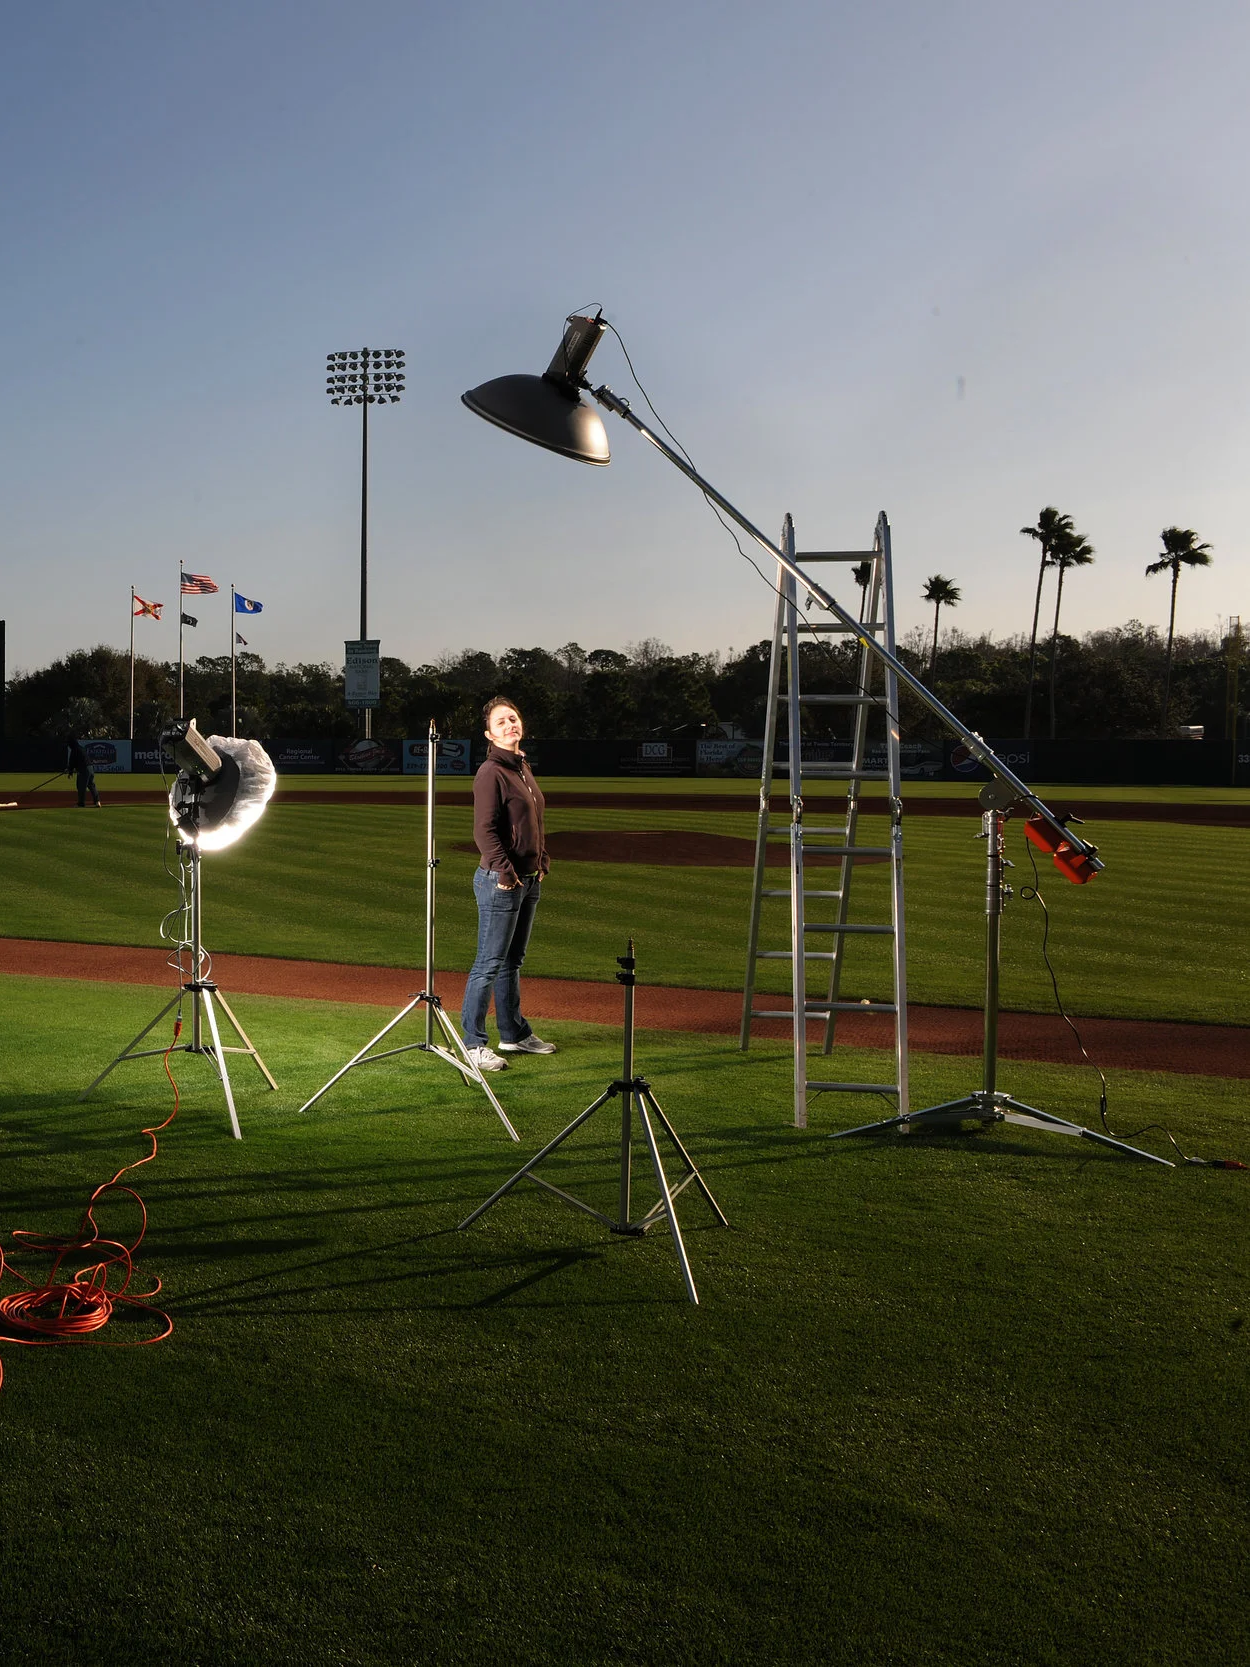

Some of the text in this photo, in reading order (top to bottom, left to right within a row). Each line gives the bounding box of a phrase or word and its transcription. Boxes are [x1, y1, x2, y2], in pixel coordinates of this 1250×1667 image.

[346, 657, 378, 665] Edison
[645, 744, 665, 755] DCG
[997, 751, 1031, 764] epsi
